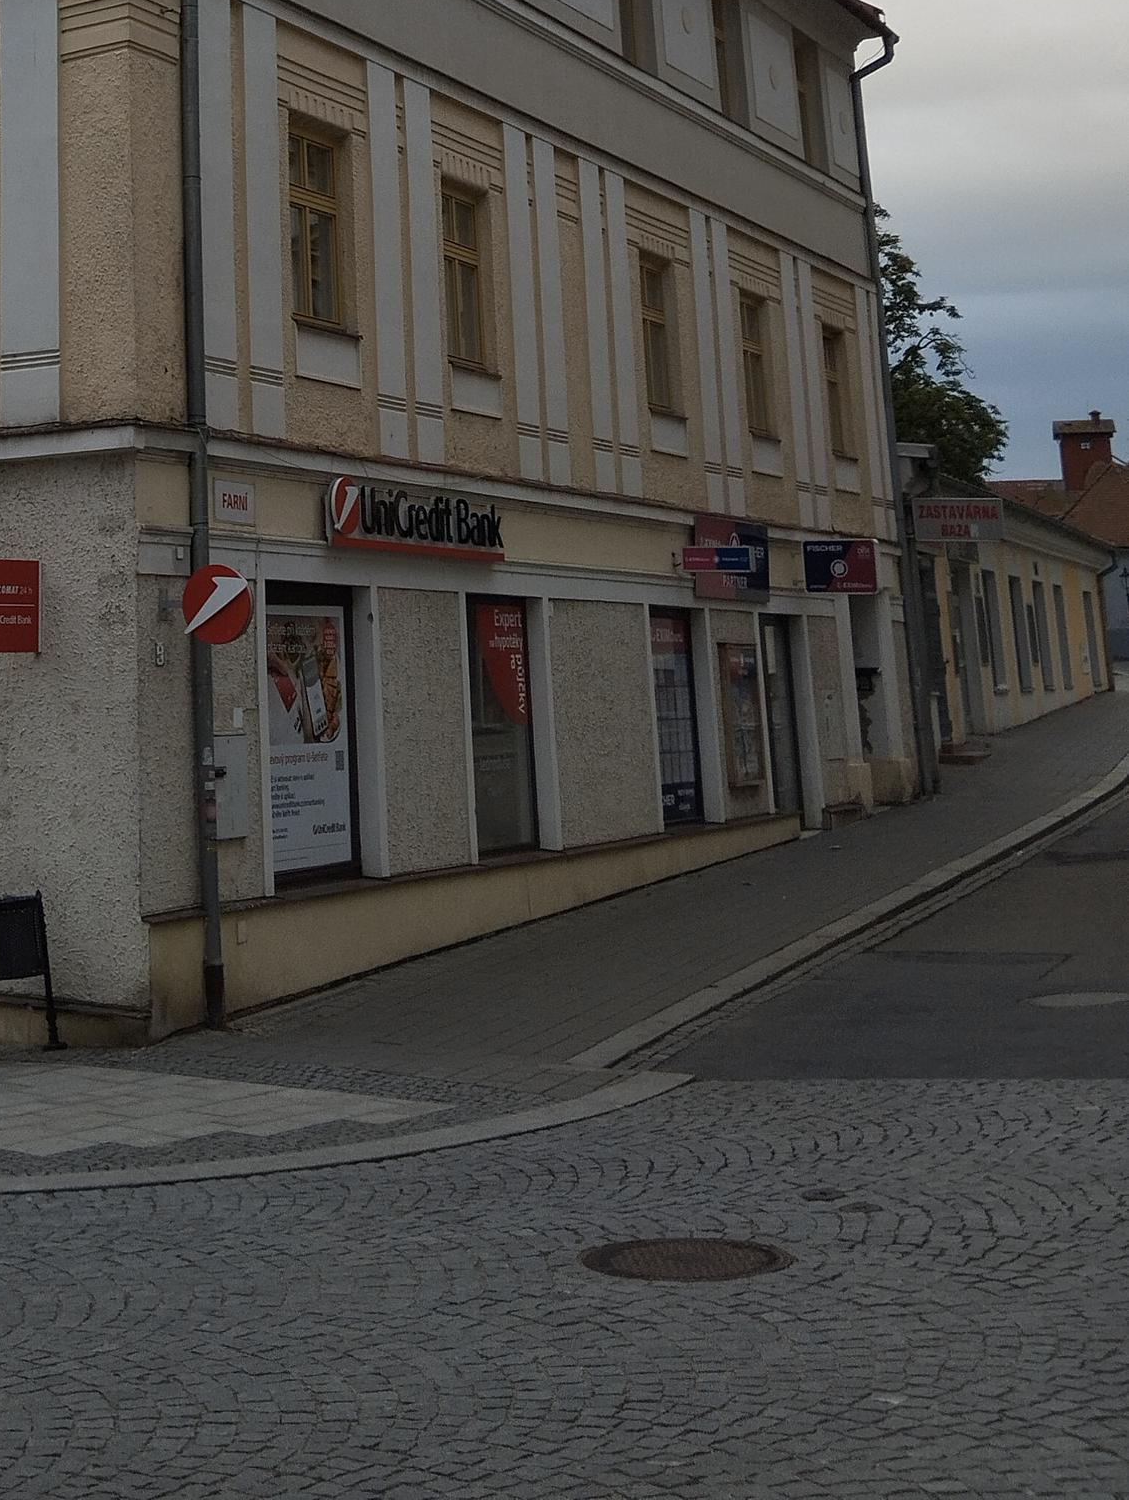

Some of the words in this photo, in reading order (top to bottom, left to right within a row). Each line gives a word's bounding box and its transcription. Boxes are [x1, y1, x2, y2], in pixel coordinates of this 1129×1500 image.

[222, 492, 248, 511] FARNÍ
[360, 484, 453, 543] UniCredit
[455, 498, 504, 548] Bank
[941, 523, 979, 538] BAZA
[806, 544, 843, 552] FISCHER
[17, 615, 33, 625] Bank
[494, 609, 523, 632] Expert
[494, 633, 524, 652] hypotéky
